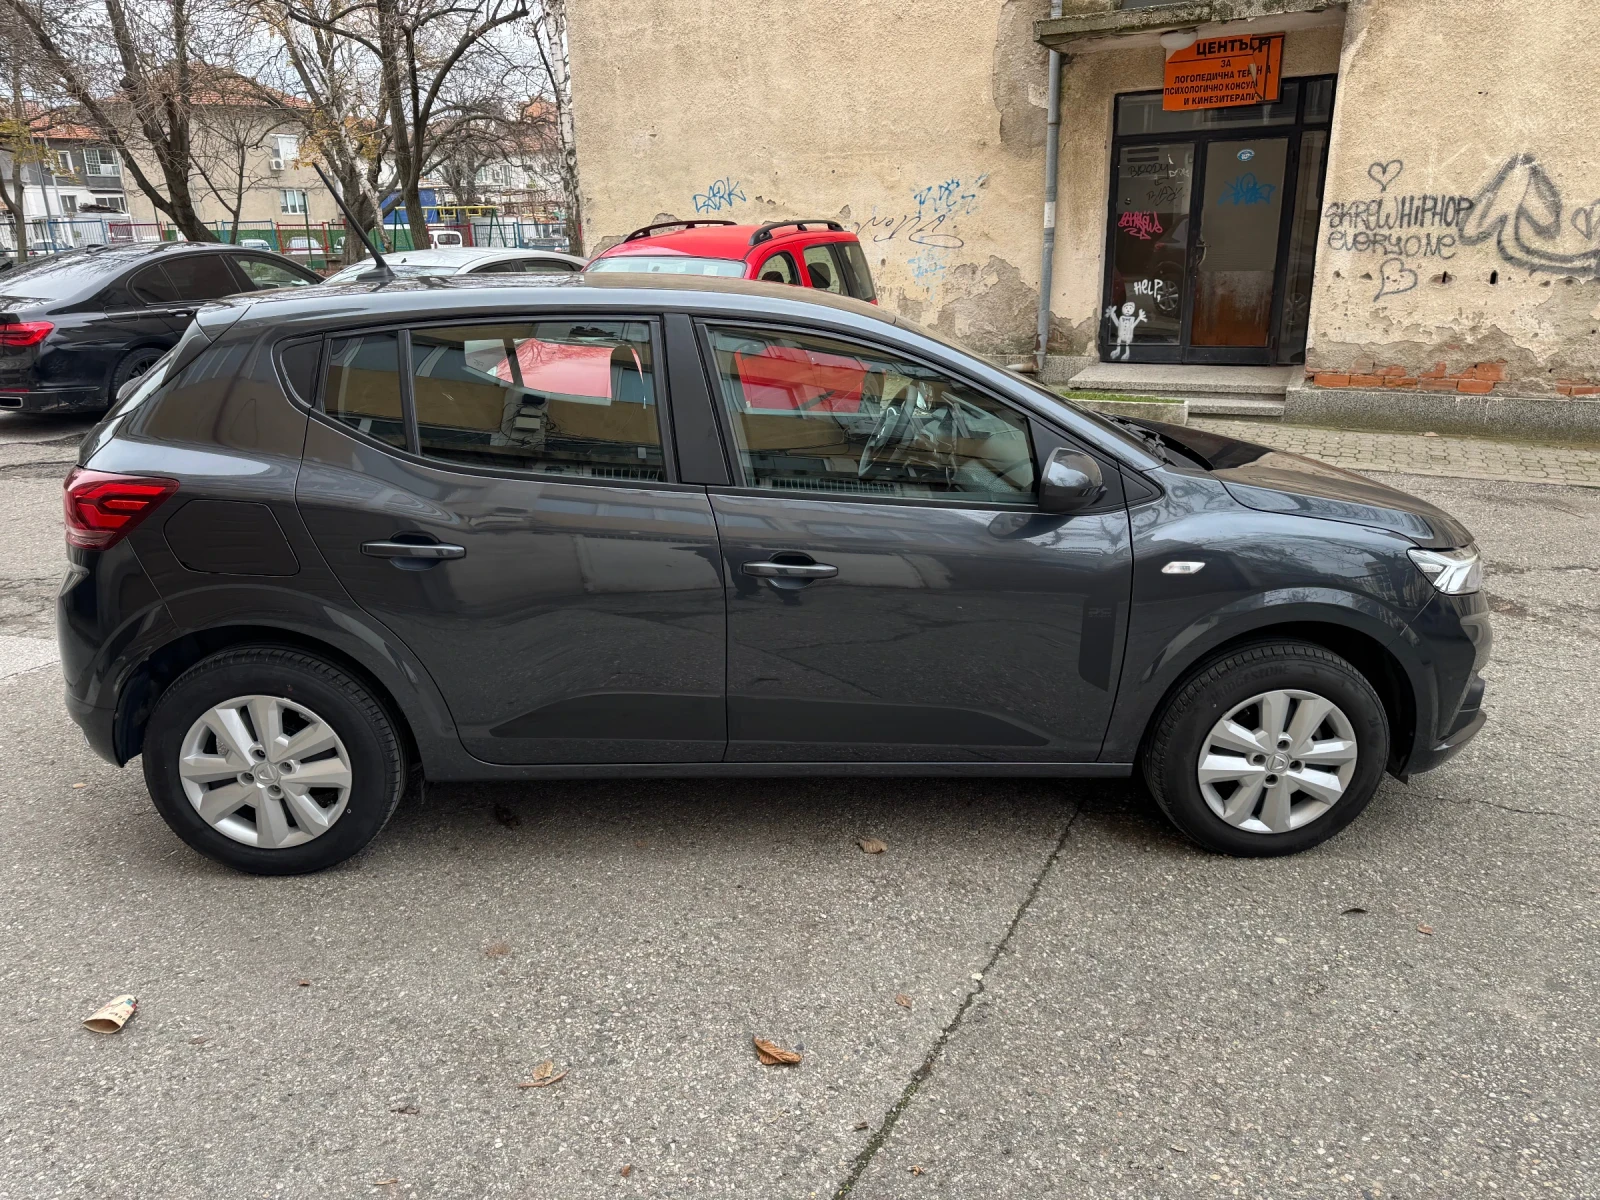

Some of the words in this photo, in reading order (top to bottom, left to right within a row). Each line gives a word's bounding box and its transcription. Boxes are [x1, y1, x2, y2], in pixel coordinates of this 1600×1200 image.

[1220, 59, 1232, 68] ЗА
[1174, 71, 1235, 84] ЛОГОПЕДИЧНА
[1165, 84, 1223, 96] ПСИХОЛОГИЧНО
[1183, 97, 1190, 106] И
